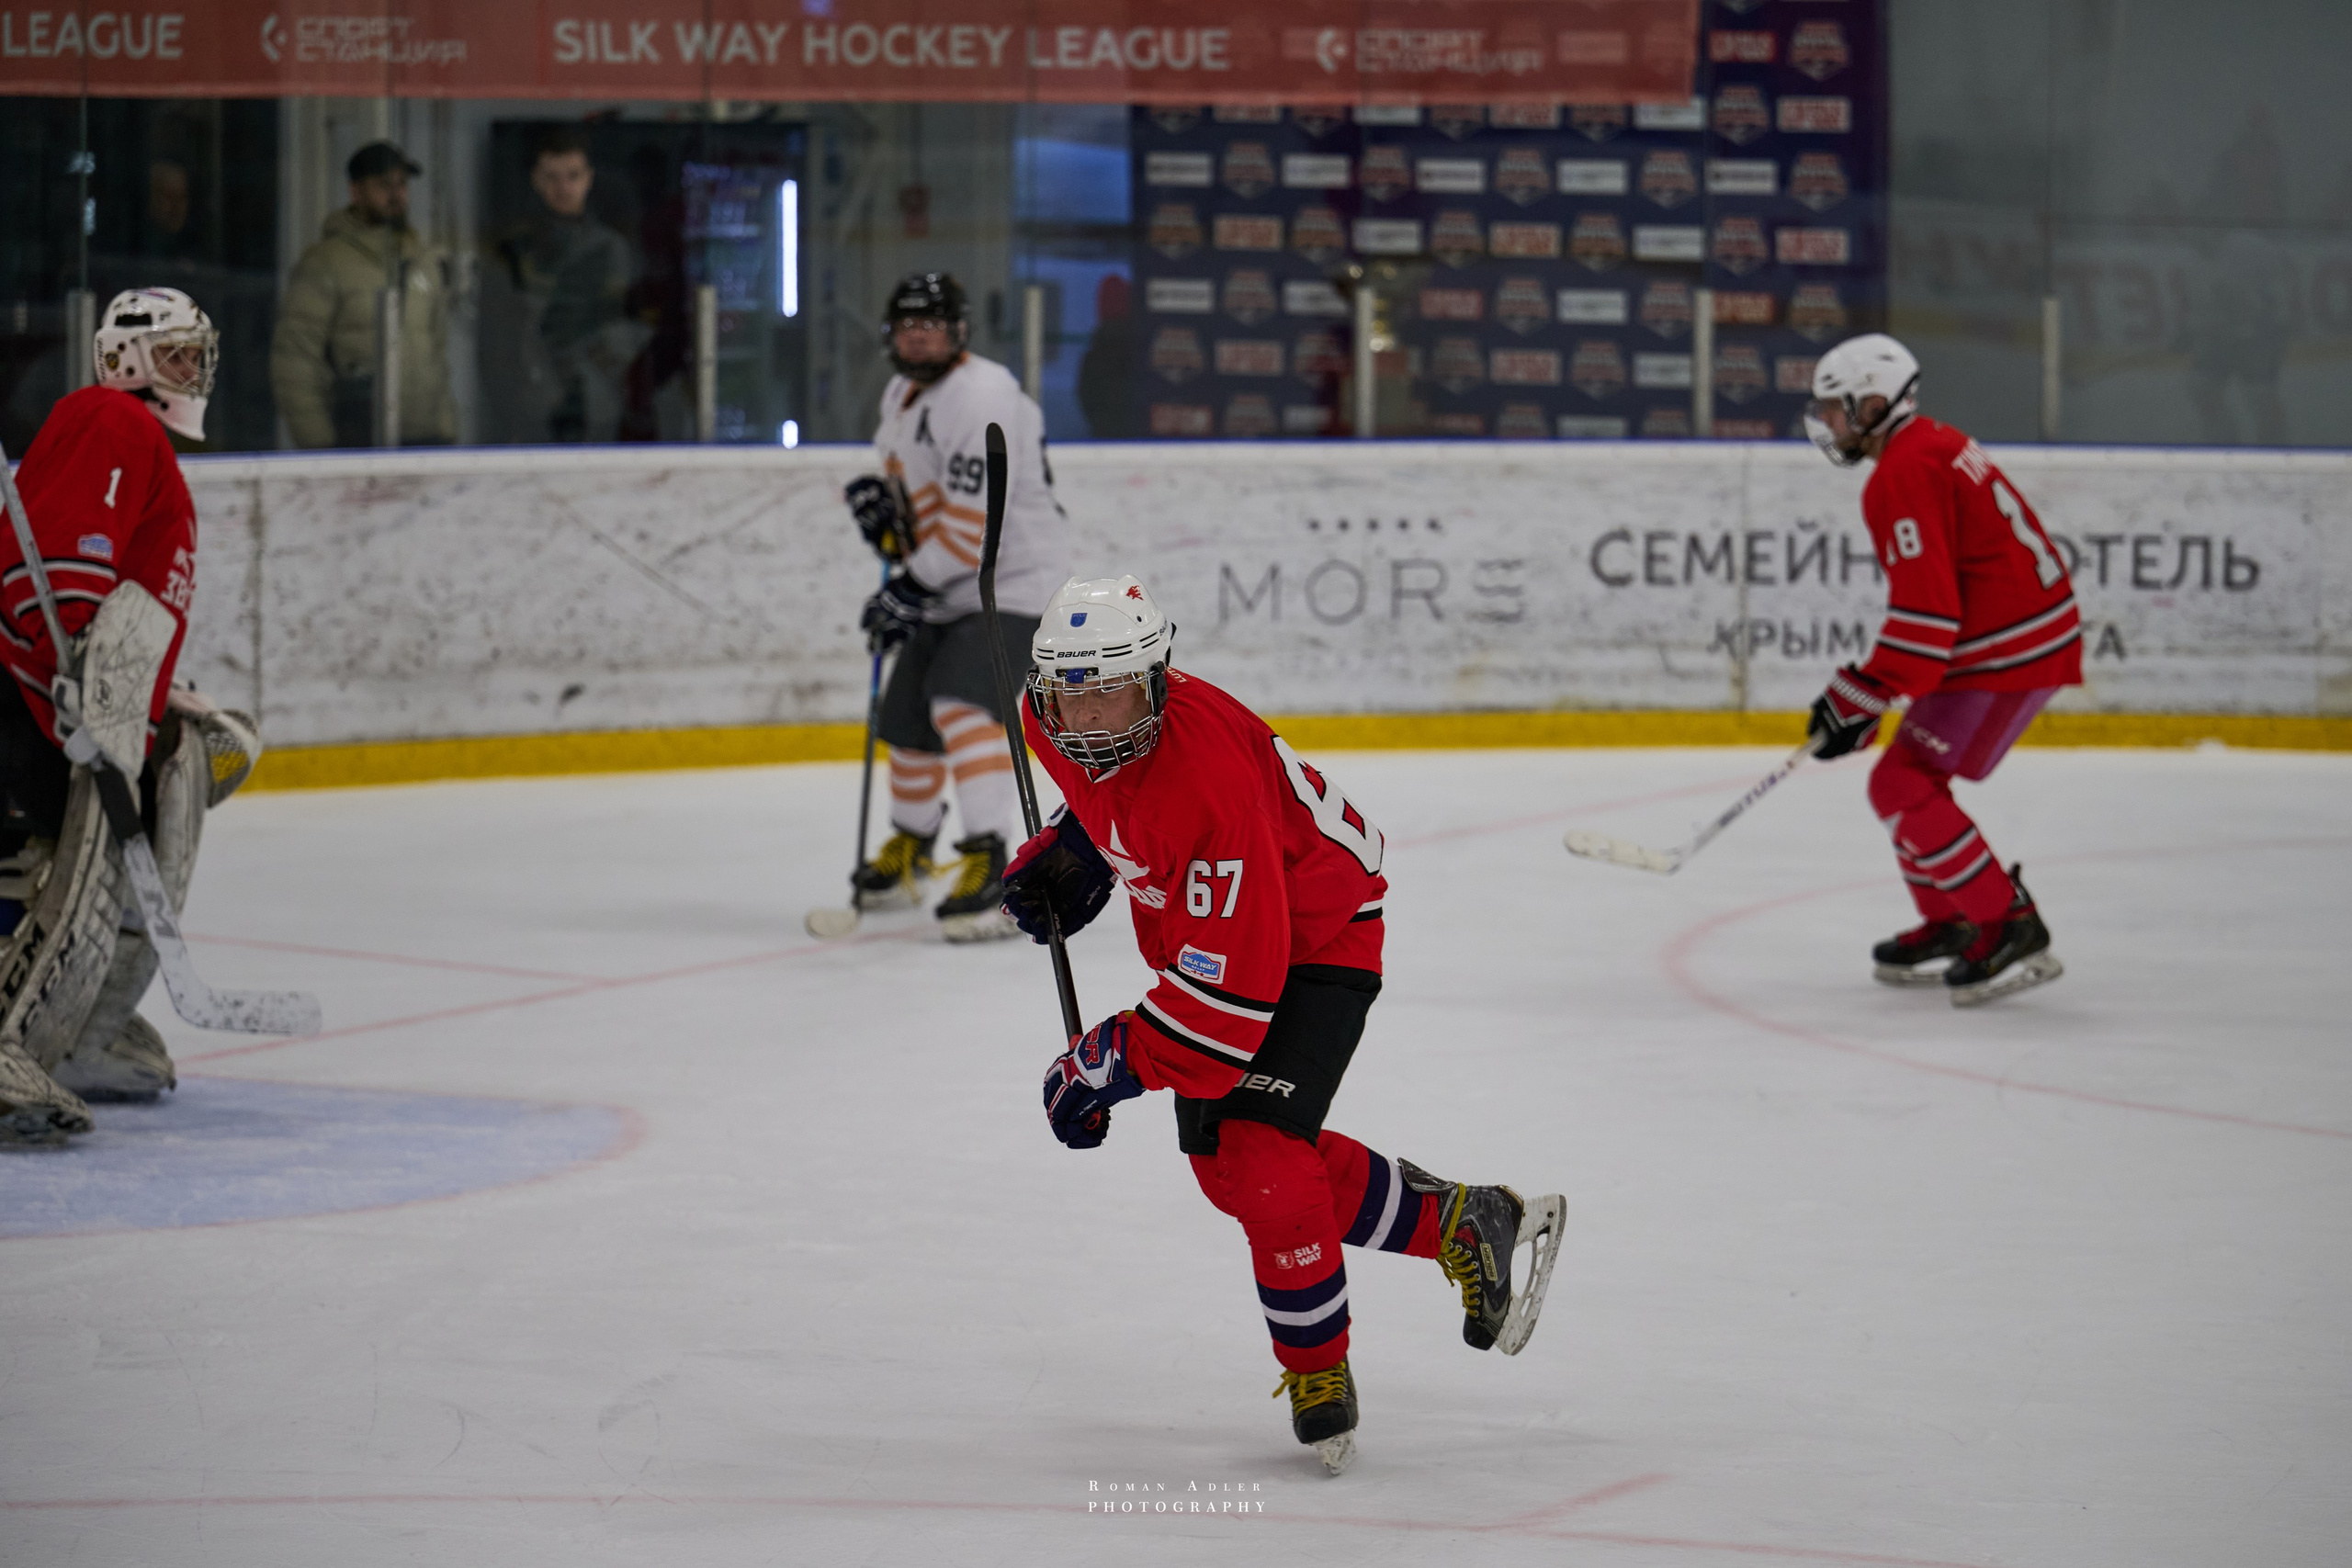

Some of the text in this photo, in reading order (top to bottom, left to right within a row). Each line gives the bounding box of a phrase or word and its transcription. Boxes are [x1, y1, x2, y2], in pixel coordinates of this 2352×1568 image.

[3, 10, 184, 60] LEAGUE
[553, 19, 1230, 71] SILK WAY HOCKEY LEAGUE
[104, 467, 122, 509] 1
[1589, 518, 1883, 588] СЕМЕЙН
[1270, 735, 1383, 877] 6
[1185, 858, 1244, 919] 67
[0, 921, 46, 1029] CM
[1183, 955, 1200, 966] SILK
[1199, 961, 1217, 971] WAY
[1294, 1242, 1321, 1258] SILK
[1296, 1250, 1322, 1267] WAY
